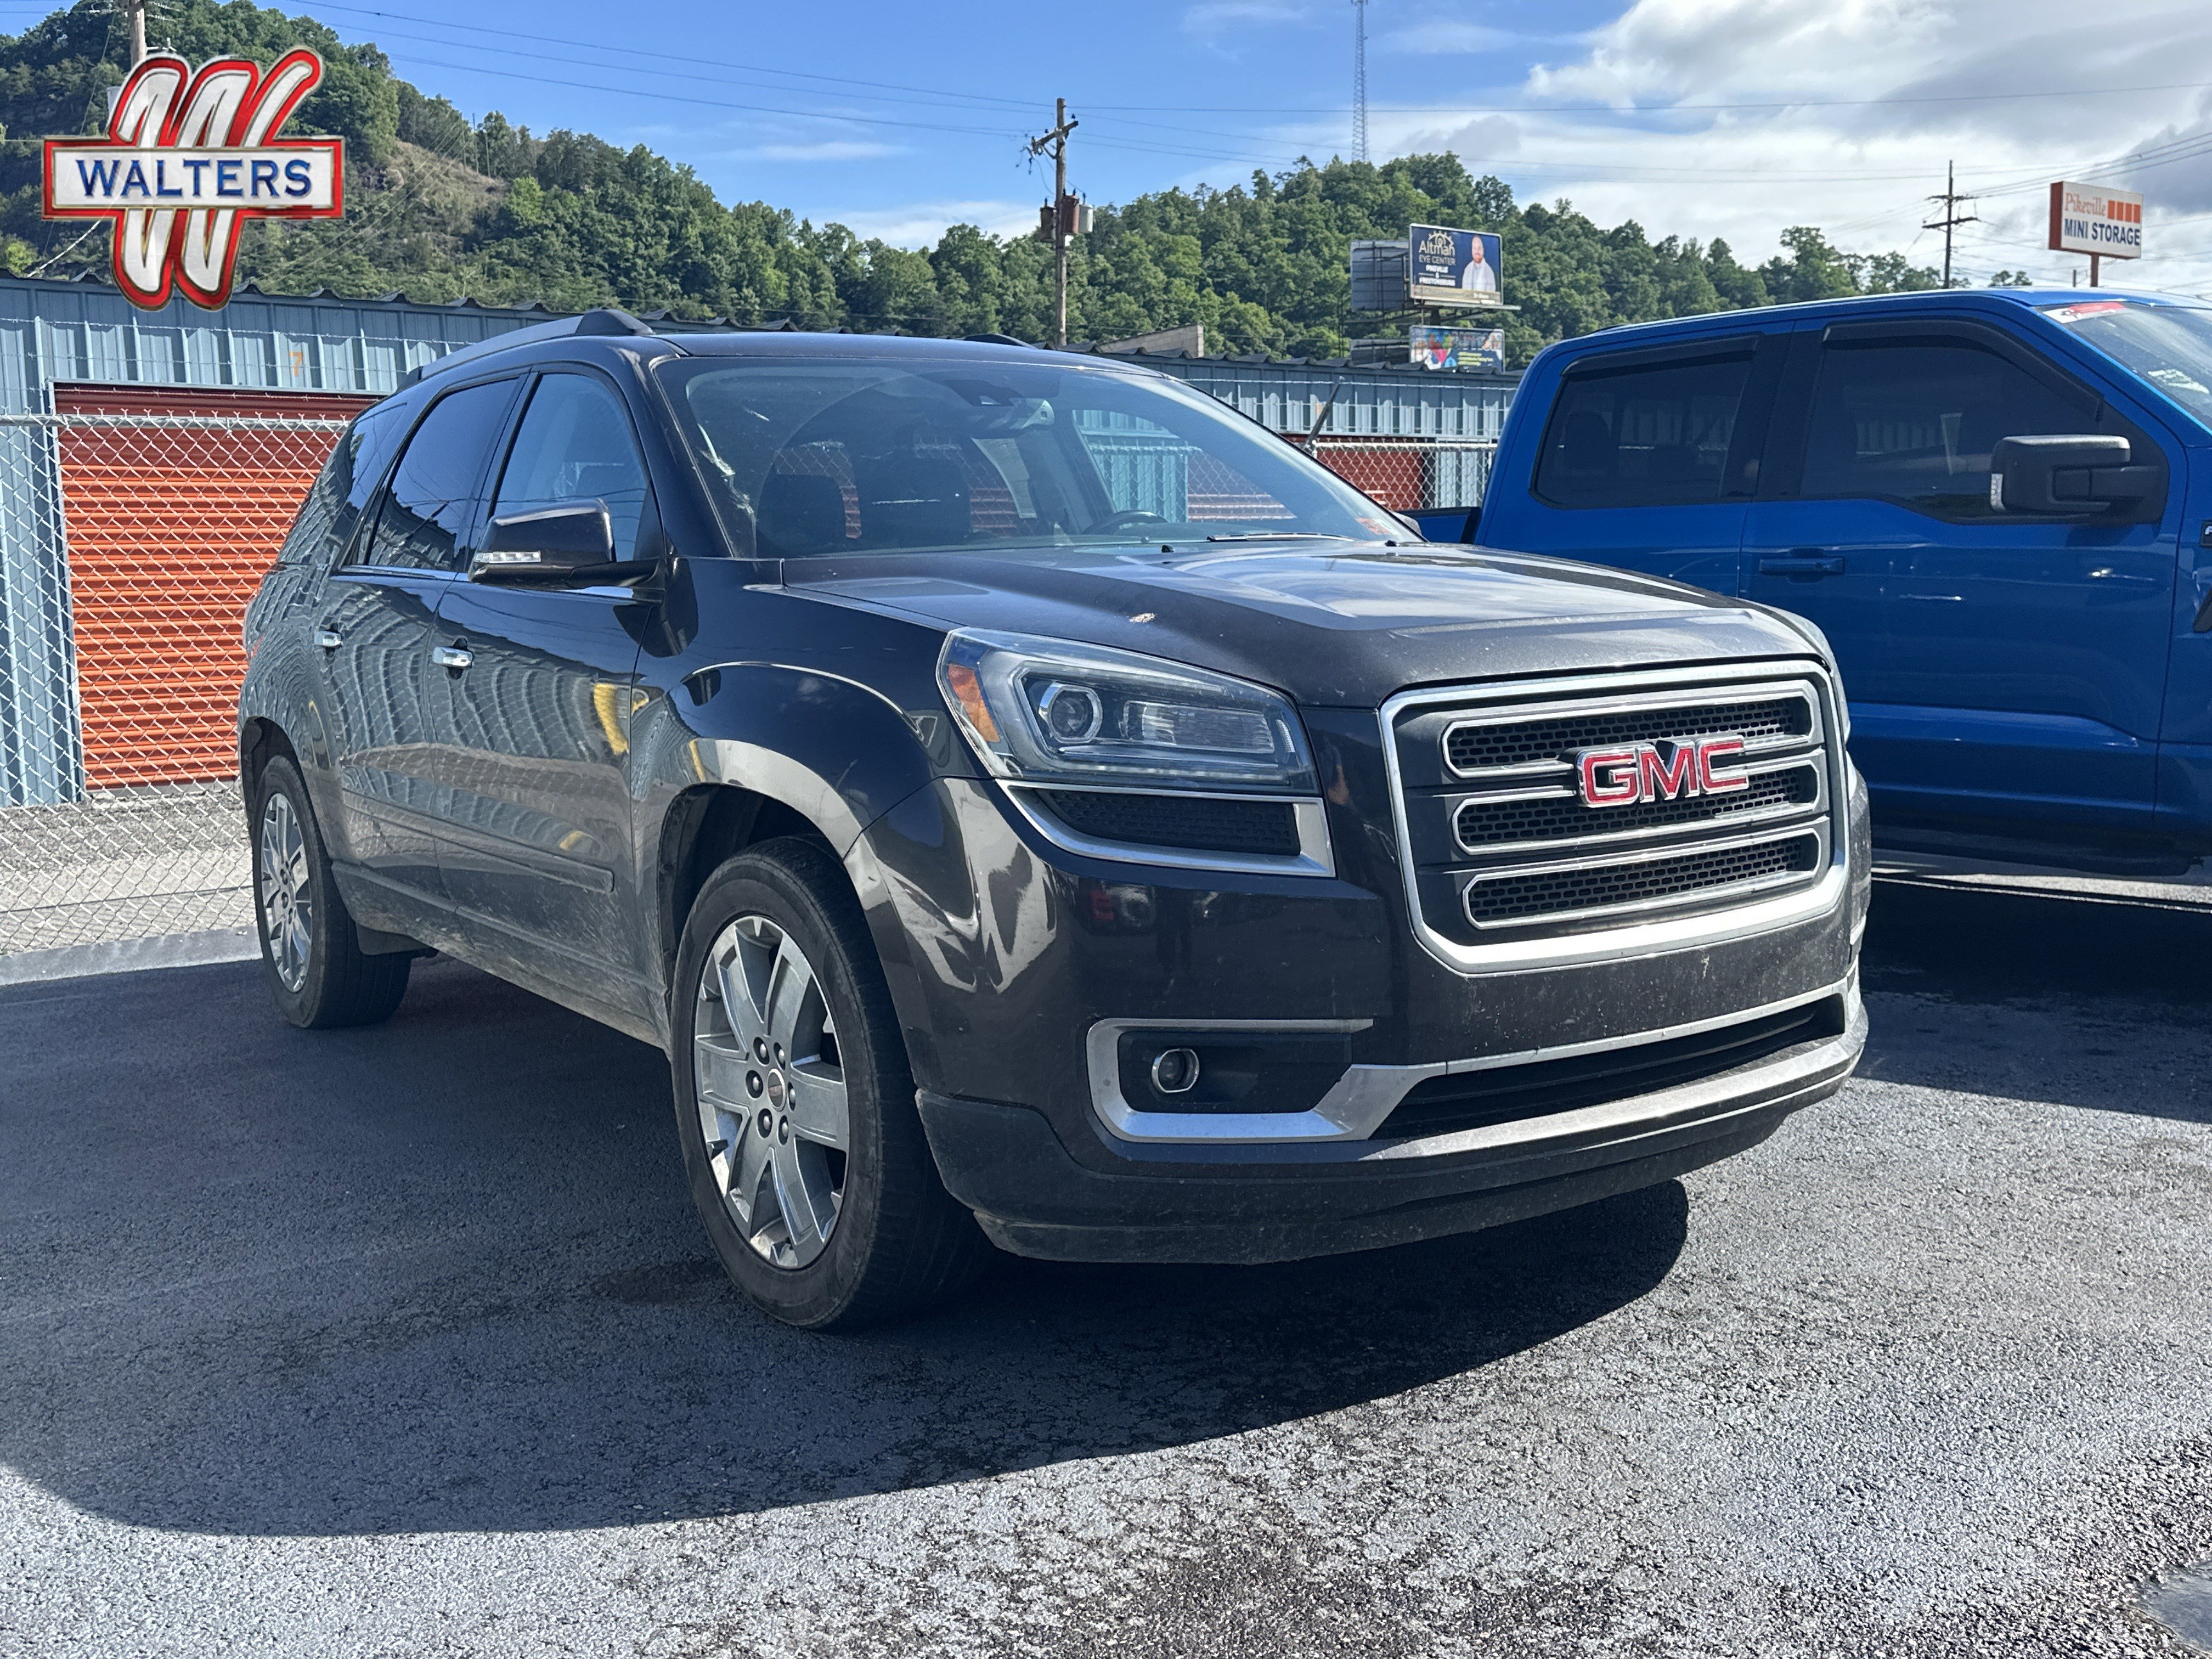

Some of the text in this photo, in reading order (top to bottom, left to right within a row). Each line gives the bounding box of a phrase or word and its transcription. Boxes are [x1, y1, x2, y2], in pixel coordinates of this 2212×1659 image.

[2064, 192, 2106, 216] Pikeville
[2064, 218, 2141, 246] MINI STORAGE
[1419, 240, 1455, 257] Altman
[1419, 255, 1455, 266] EYE CENTER
[289, 351, 304, 377] 7
[1576, 735, 1749, 808] GMC
